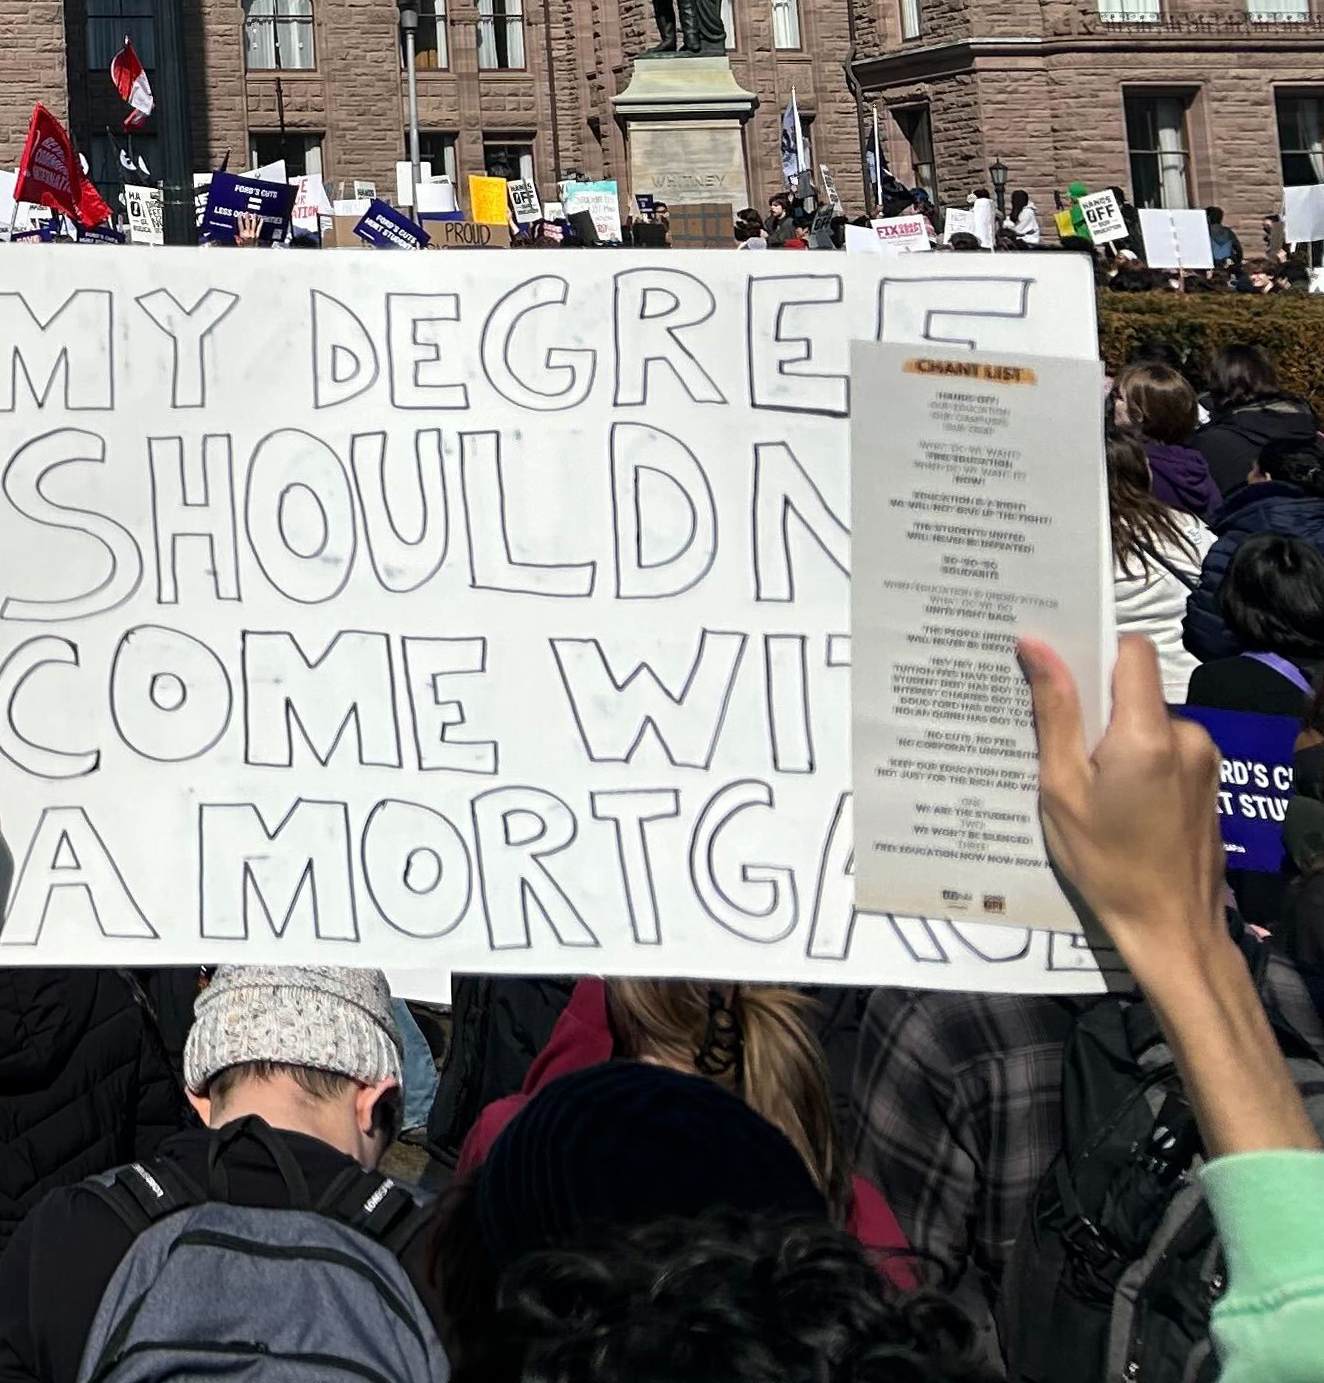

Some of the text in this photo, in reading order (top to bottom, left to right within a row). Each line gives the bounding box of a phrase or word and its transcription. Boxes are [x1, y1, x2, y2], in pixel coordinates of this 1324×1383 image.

[651, 172, 726, 188] WHITNEY
[234, 184, 278, 199] FORD'S CUTS
[513, 189, 535, 206] OFF
[213, 205, 233, 217] LESS
[1082, 195, 1112, 210] HANDS
[1085, 204, 1116, 224] OFF
[445, 222, 491, 246] PROUD
[876, 225, 900, 241] FIX
[916, 358, 1024, 383] CHANT LIST
[892, 664, 936, 676] TUITION
[990, 673, 1012, 684] GOT
[549, 626, 851, 774] WI
[1219, 759, 1270, 789] RD'S
[900, 845, 959, 859] EDUCATION
[960, 851, 986, 862] NOW
[987, 854, 1014, 865] NOW
